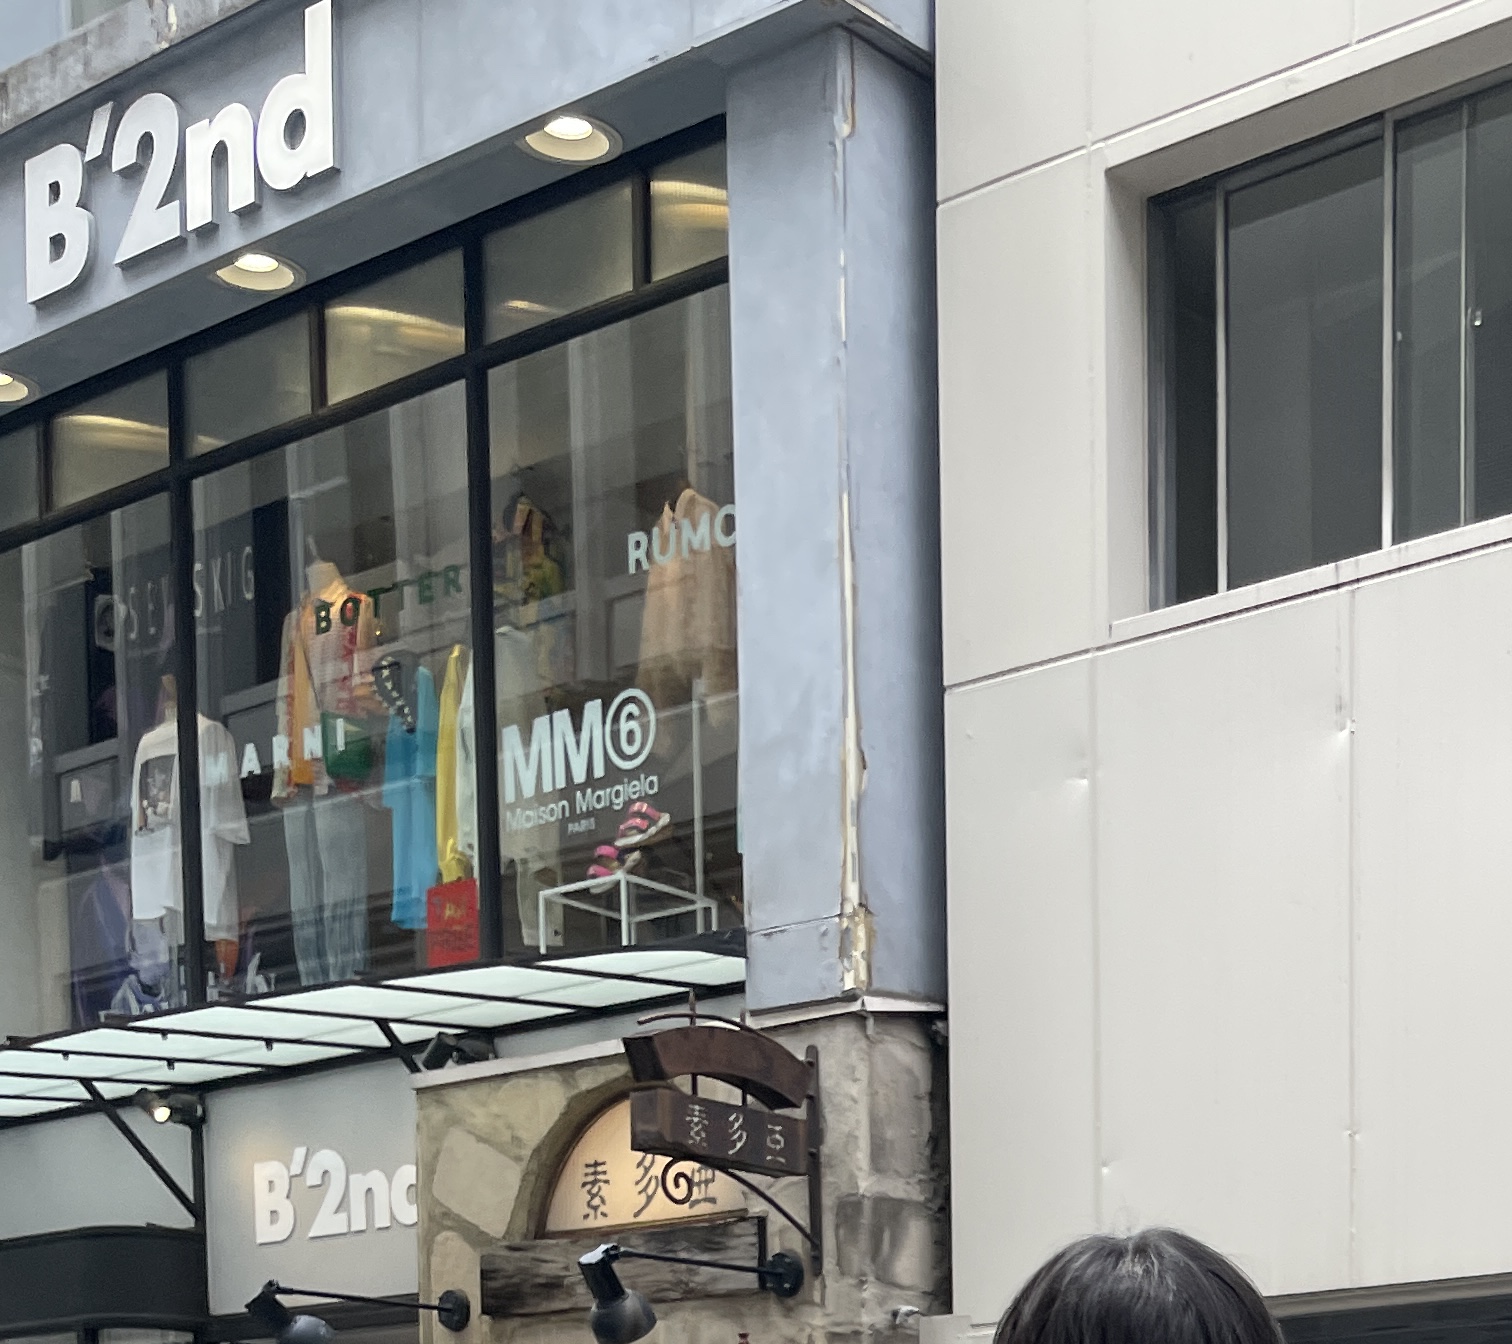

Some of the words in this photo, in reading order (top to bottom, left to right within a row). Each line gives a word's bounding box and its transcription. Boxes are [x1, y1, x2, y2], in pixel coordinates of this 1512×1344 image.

[24, 0, 334, 304] B'2nd
[204, 717, 346, 787] MARNI
[505, 799, 570, 834] Maison
[575, 773, 659, 811] Margiela
